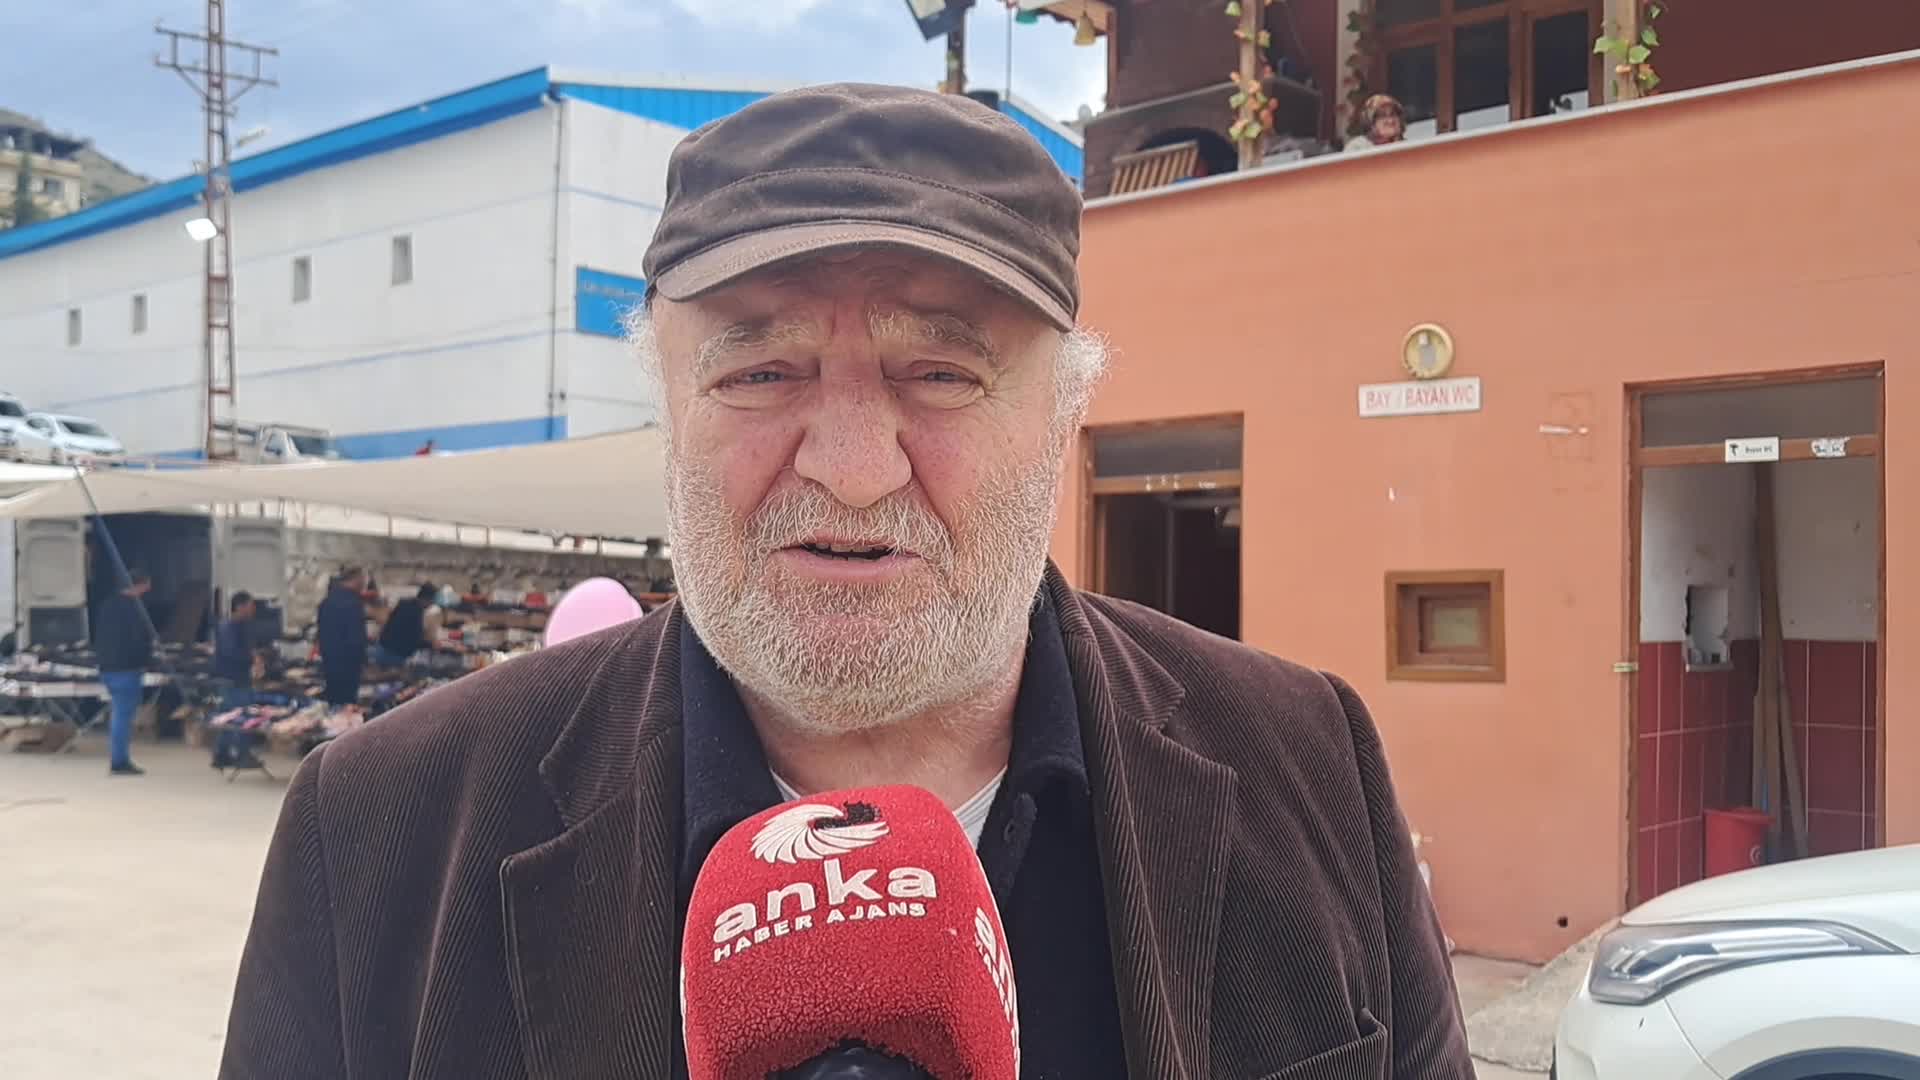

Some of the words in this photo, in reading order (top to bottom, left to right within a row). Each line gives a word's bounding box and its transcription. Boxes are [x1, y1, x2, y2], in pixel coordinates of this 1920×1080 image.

[1366, 391, 1391, 410] BAY
[1406, 386, 1449, 407] BAYAN
[1452, 384, 1474, 404] WC
[713, 858, 938, 943] anka
[714, 915, 814, 964] HABER
[826, 902, 927, 924] AJANS
